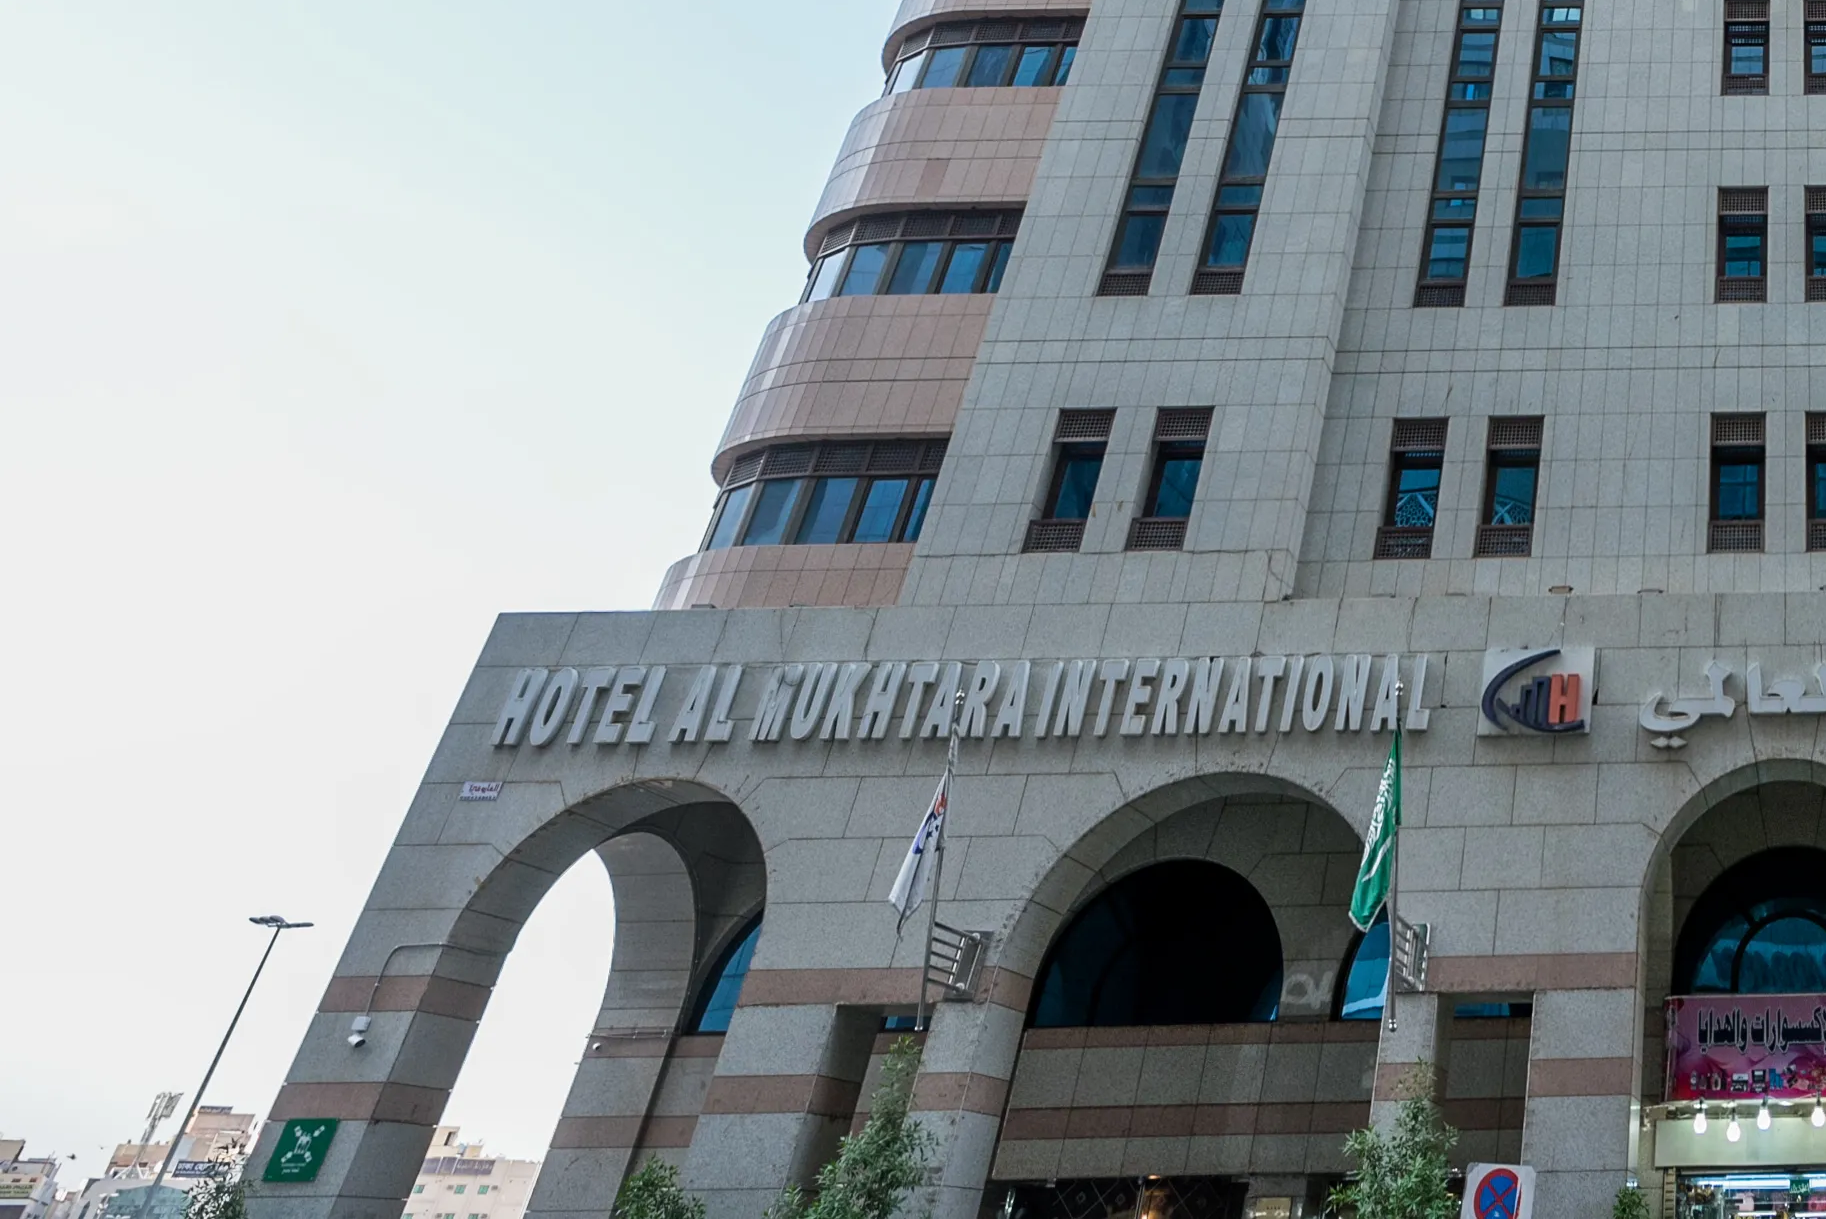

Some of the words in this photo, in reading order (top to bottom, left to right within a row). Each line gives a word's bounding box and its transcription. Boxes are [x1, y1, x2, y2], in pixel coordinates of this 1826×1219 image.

[489, 665, 667, 747] HOTEL
[667, 664, 743, 744] AL
[747, 660, 1030, 743] MUKHTARA
[1034, 653, 1431, 740] INTERNATIONAL
[1697, 1005, 1748, 1056] والهدايا
